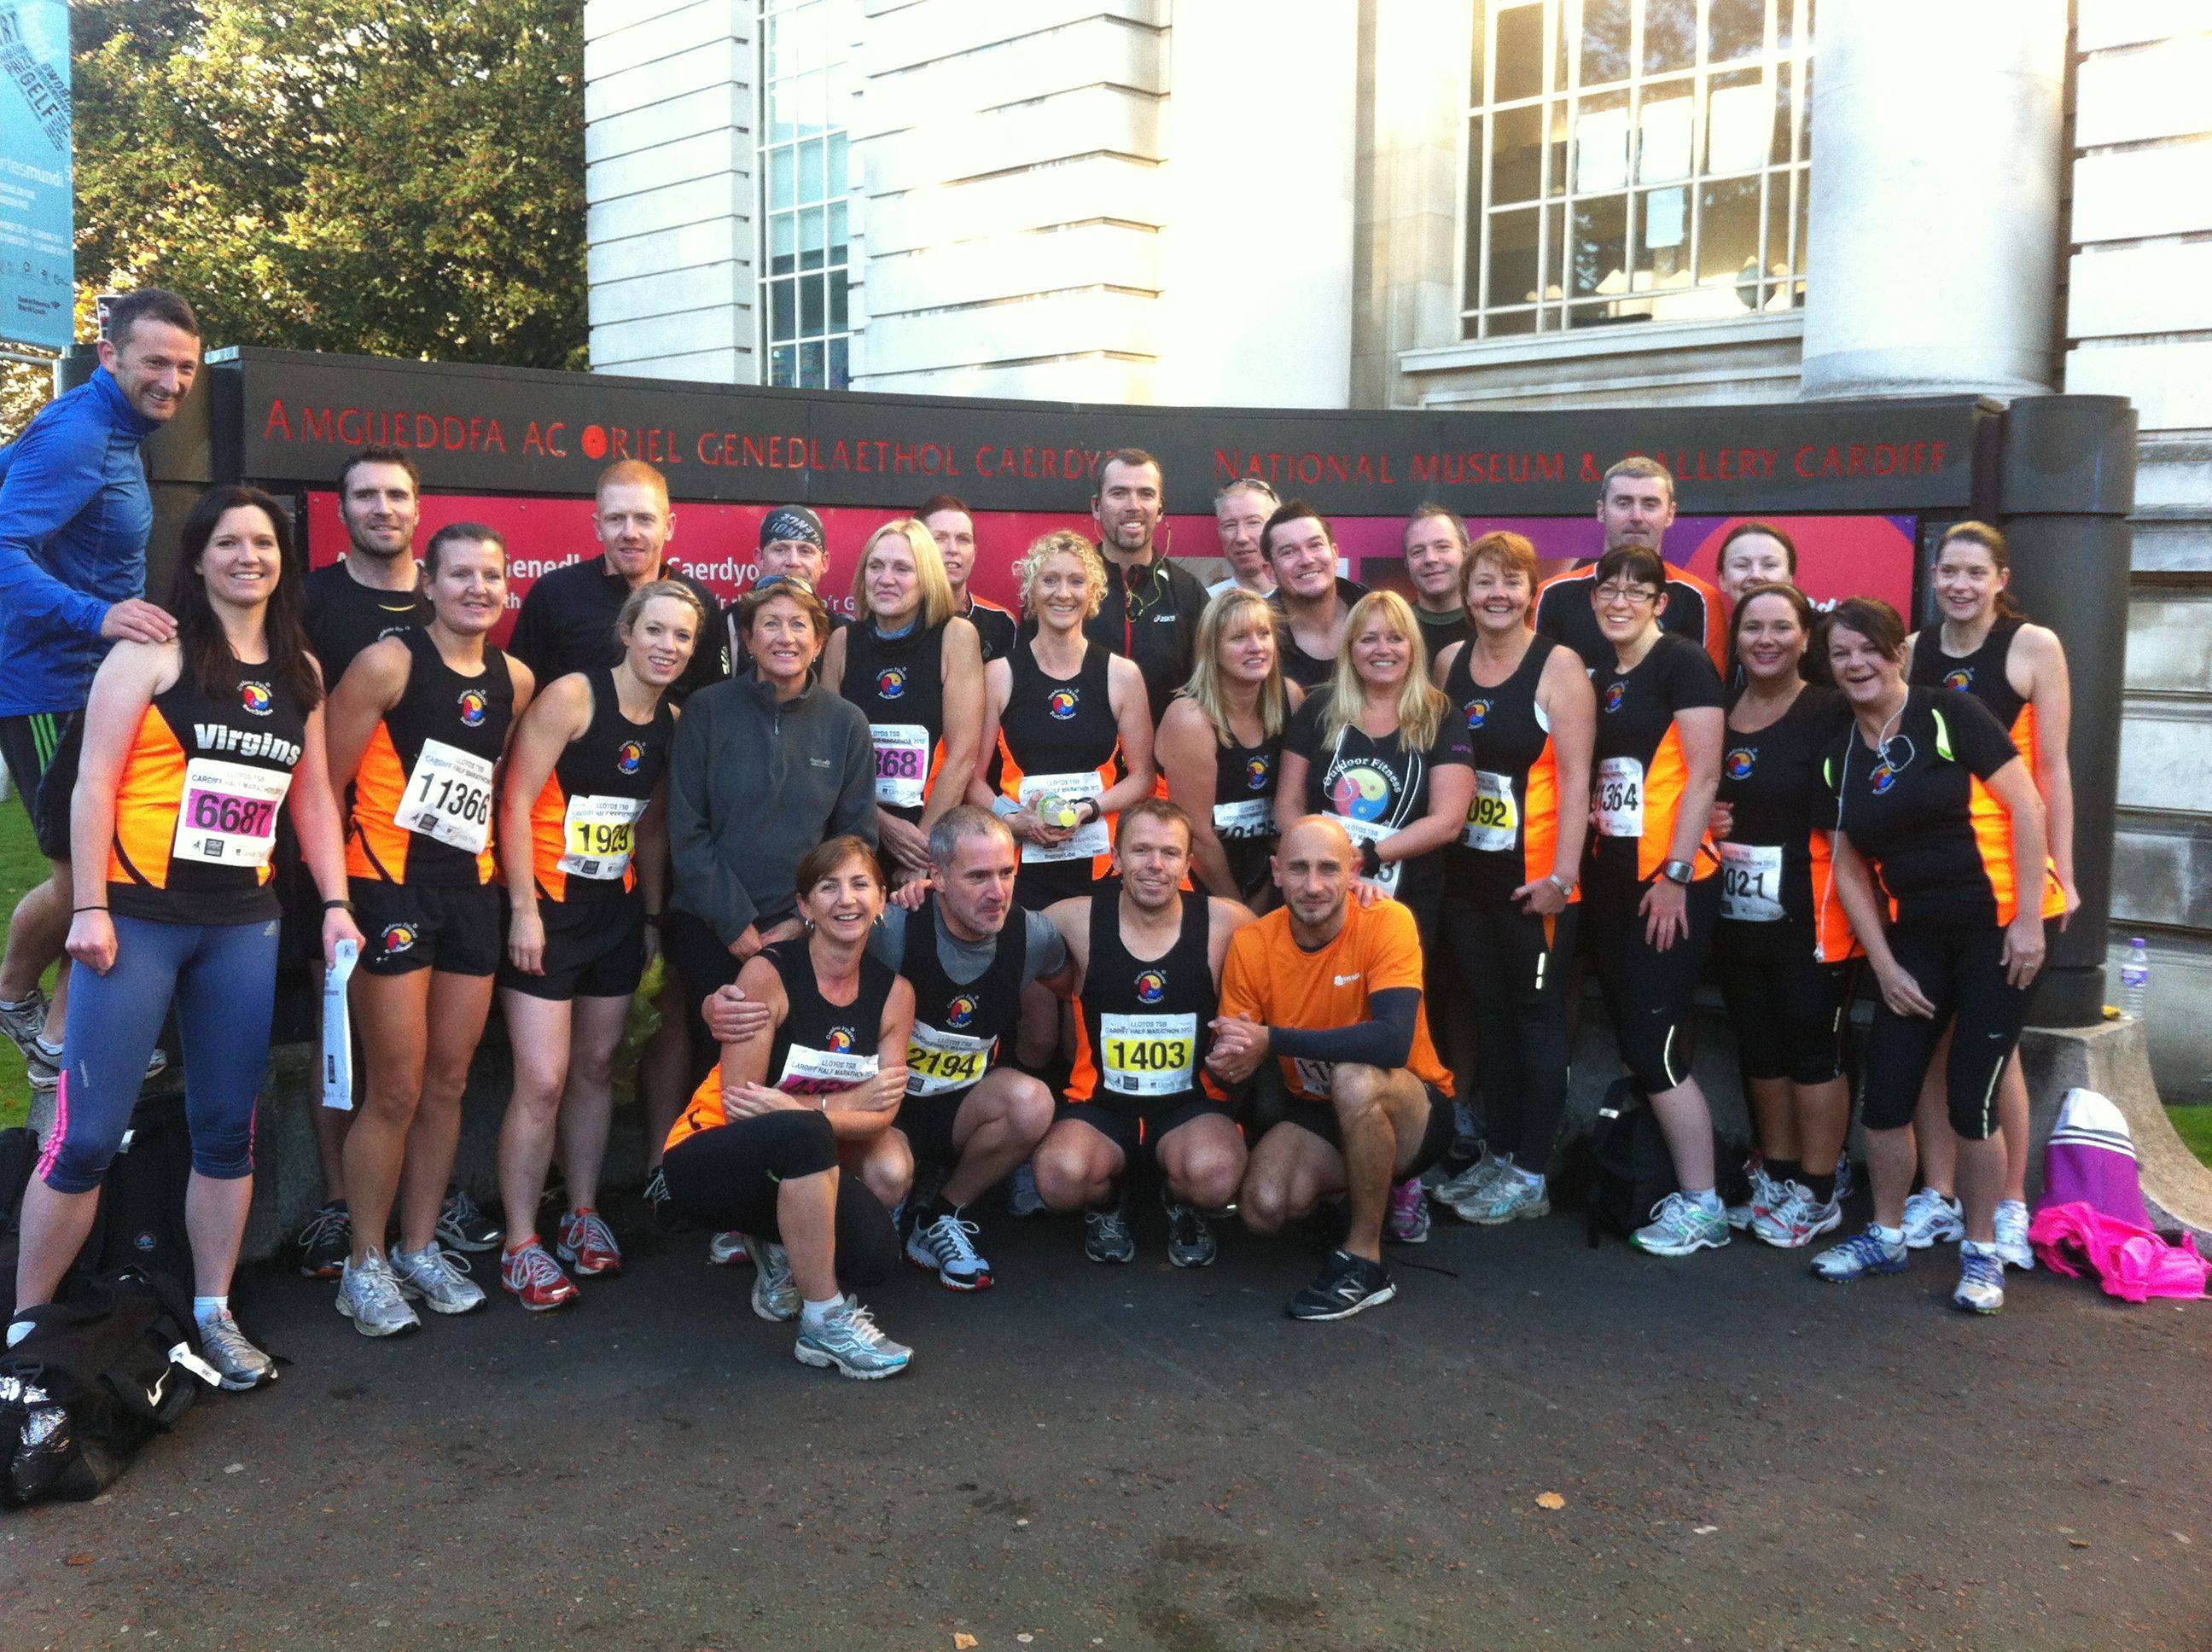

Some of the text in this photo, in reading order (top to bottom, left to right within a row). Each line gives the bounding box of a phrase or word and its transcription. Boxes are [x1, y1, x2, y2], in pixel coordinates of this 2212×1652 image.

[264, 398, 1117, 480] AMGUEDDFA AC ORIEL GENEDLAETHOL CAERDY
[1214, 441, 1947, 485] NATIONAL MUSEUM & LLERY CARDIFF
[193, 724, 300, 766] Virgins
[191, 774, 223, 784] CARDIFF
[1323, 758, 1401, 794] Outdoor Fitness
[195, 794, 272, 836] 6687
[419, 772, 491, 826] 11366
[578, 823, 631, 854] 1929
[1345, 823, 1367, 834] LLOYDS
[791, 1062, 818, 1073] CARDIFF
[818, 1066, 835, 1075] HALF
[821, 1059, 845, 1068] LLOYDS
[905, 1047, 977, 1079] 2194
[1113, 1041, 1185, 1070] 1403
